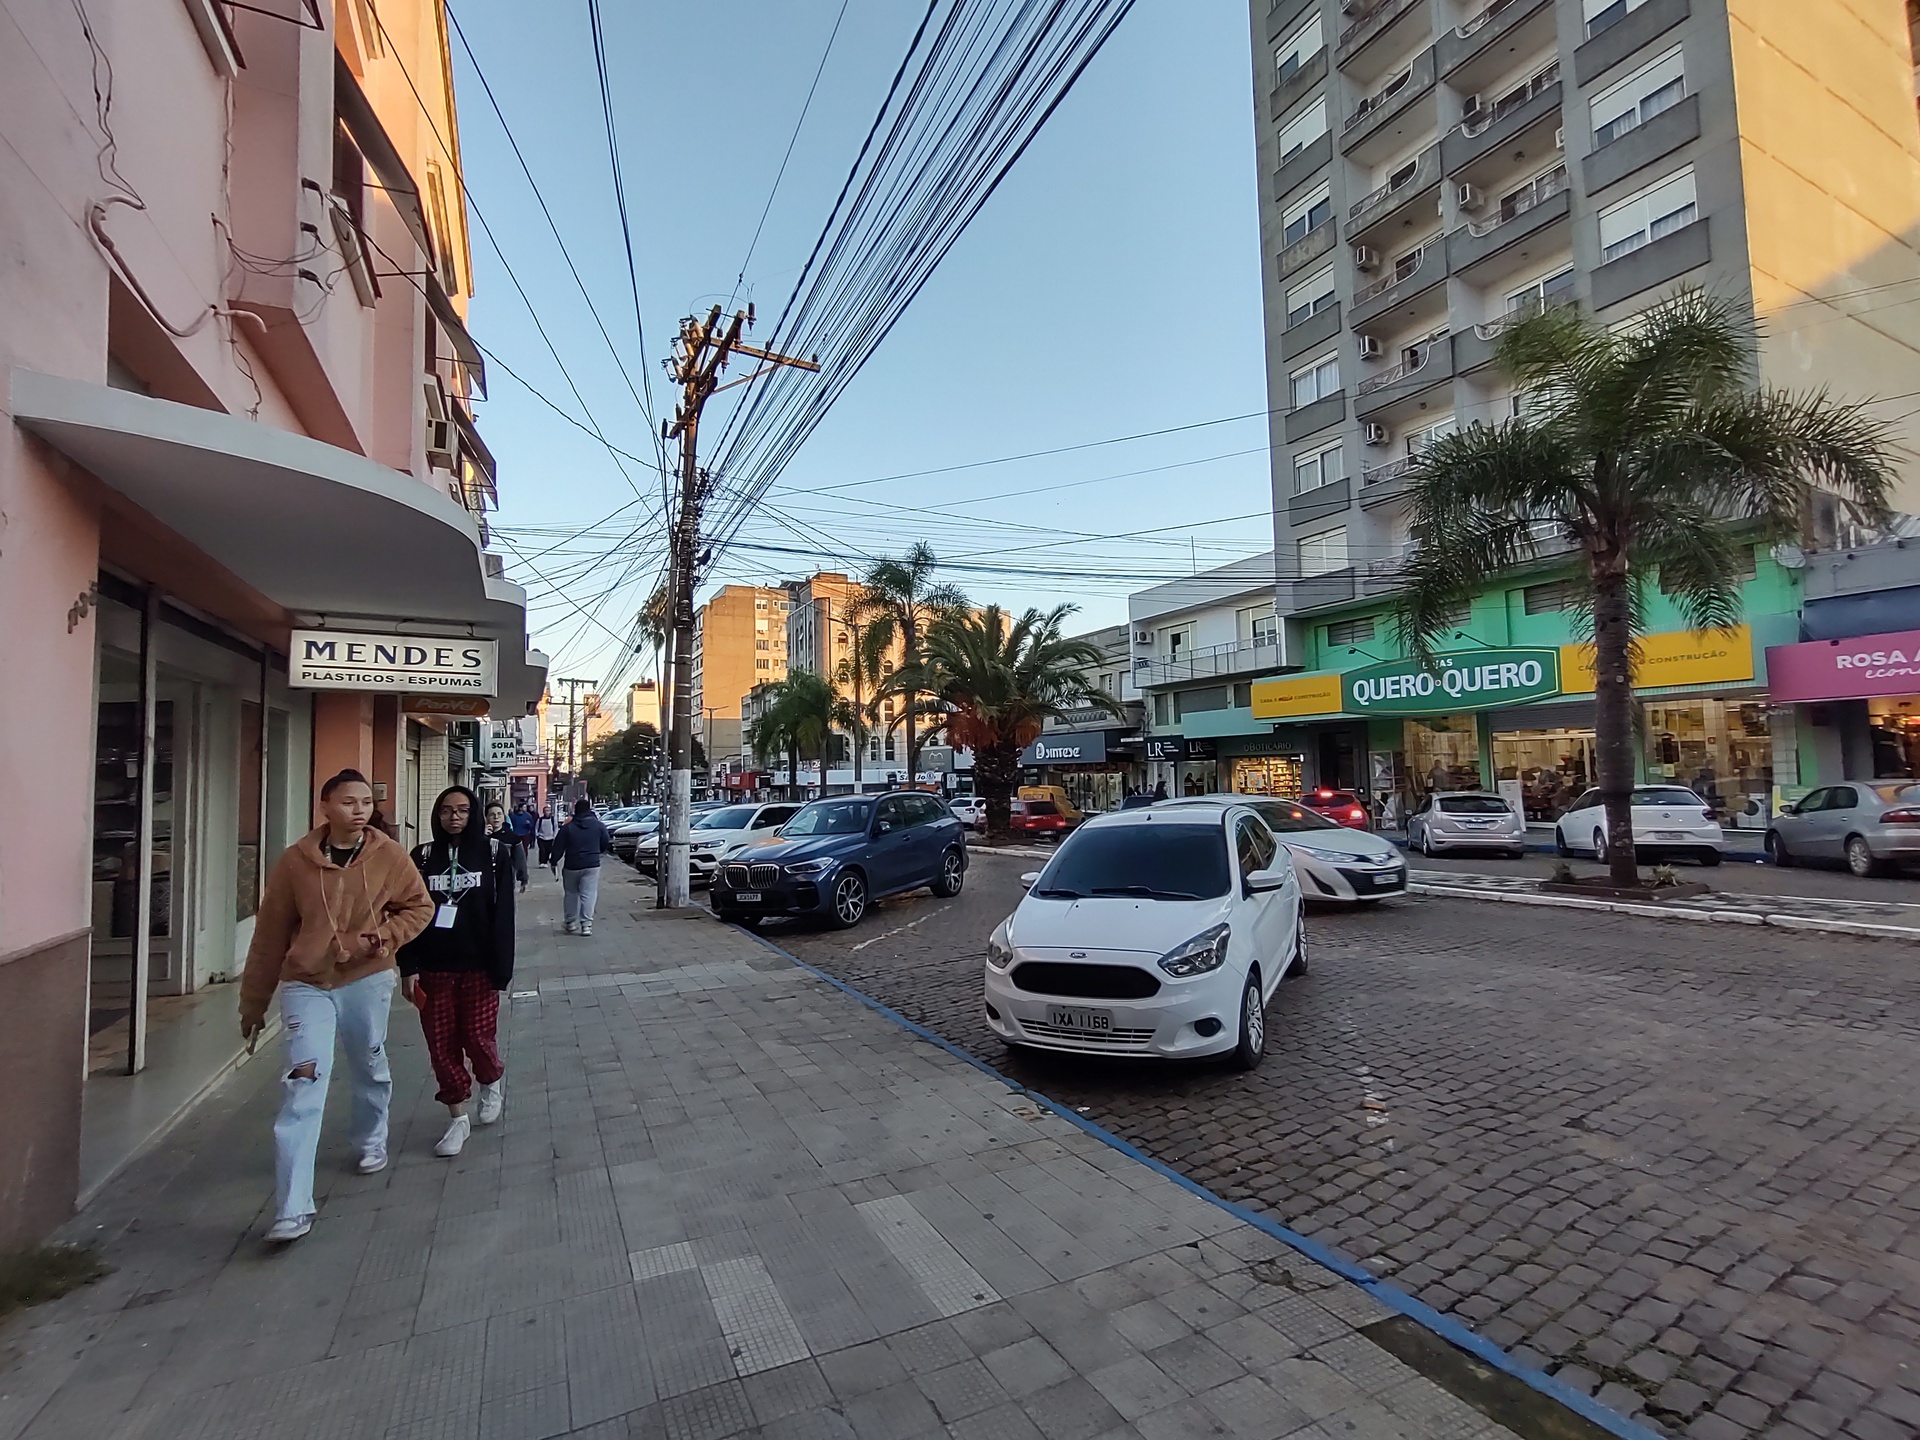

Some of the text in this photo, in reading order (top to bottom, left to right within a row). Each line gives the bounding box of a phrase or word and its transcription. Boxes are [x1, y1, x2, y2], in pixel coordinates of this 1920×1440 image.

[303, 640, 482, 669] MENDES
[1648, 650, 1728, 664] CONSTRUÇÃO
[1836, 650, 1907, 669] ROSA
[302, 671, 395, 683] PLÁSTICOS
[408, 676, 482, 687] ESPUMAS
[1147, 741, 1164, 757] LR
[1189, 741, 1203, 753] LR
[428, 871, 483, 892] THE BEST
[1053, 1012, 1074, 1027] IXA
